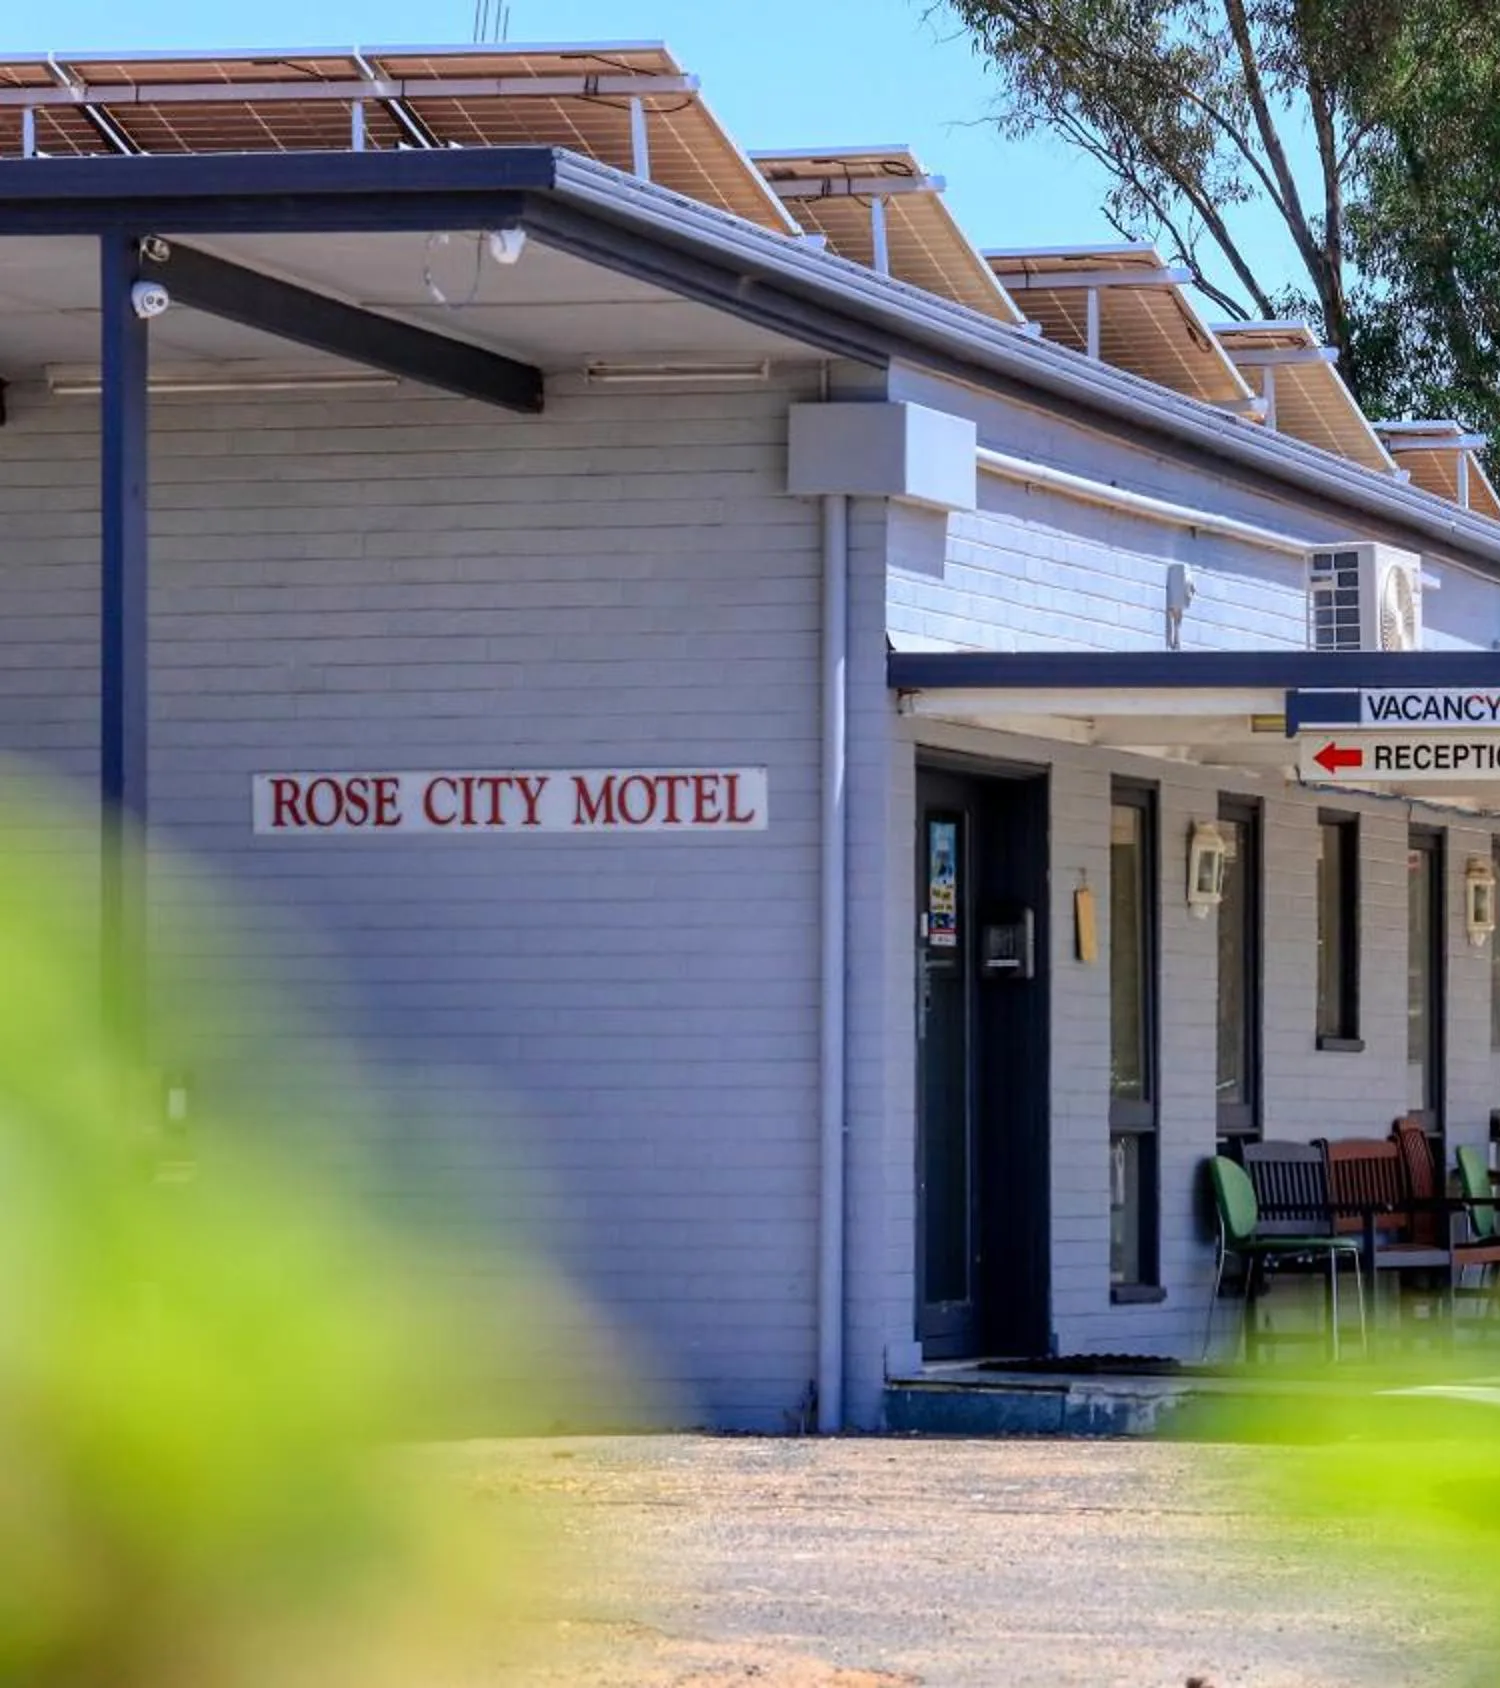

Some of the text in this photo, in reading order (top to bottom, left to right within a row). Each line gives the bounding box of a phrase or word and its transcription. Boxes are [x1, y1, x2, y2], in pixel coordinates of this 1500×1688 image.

[270, 773, 755, 827] ROSE CITY MOTEL
